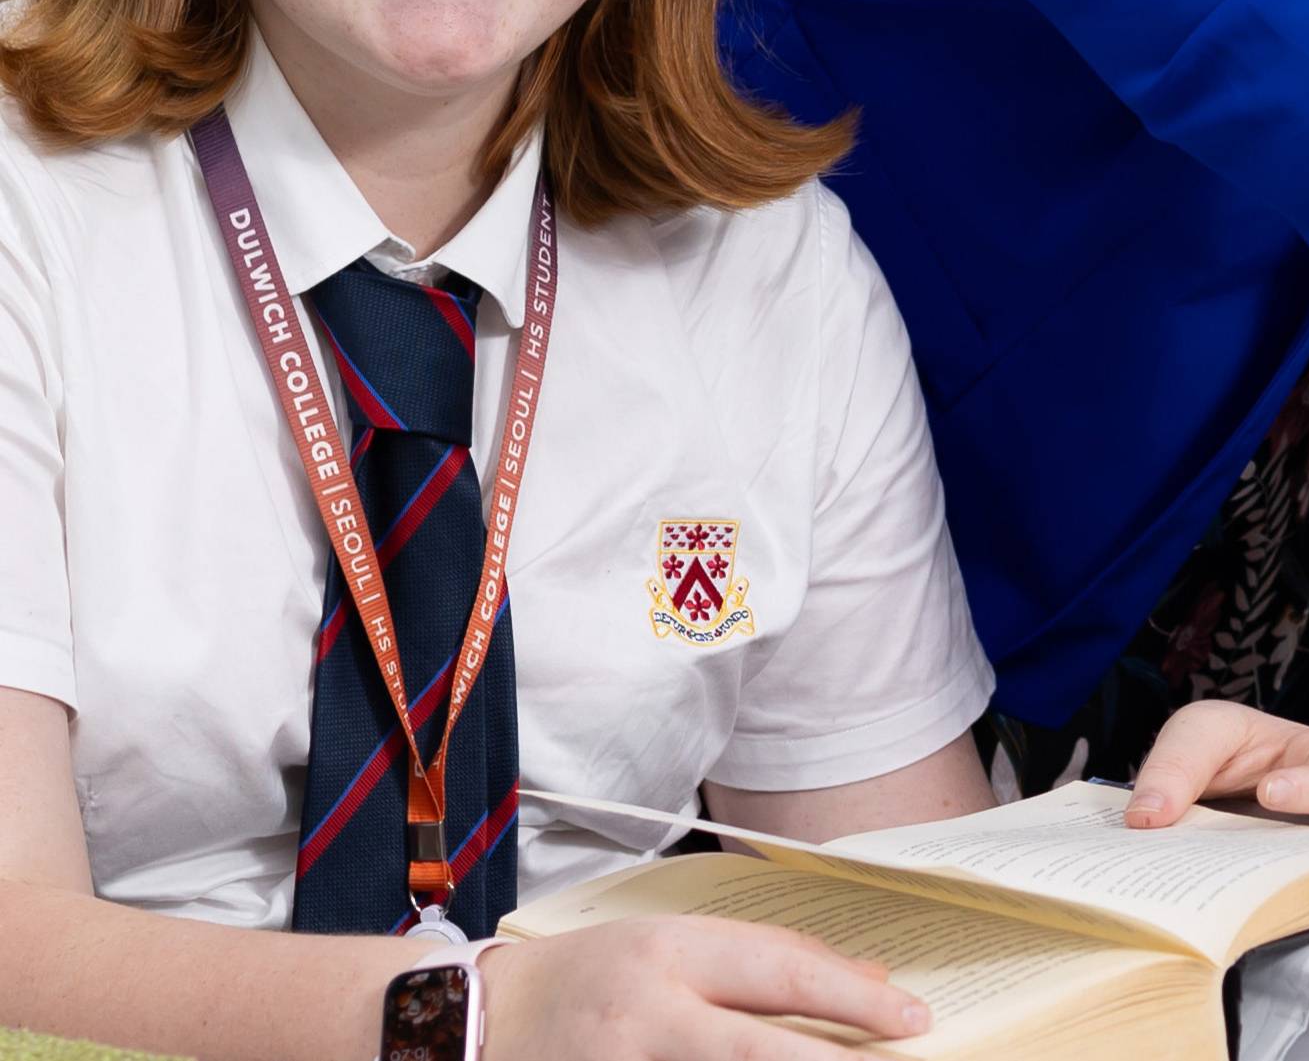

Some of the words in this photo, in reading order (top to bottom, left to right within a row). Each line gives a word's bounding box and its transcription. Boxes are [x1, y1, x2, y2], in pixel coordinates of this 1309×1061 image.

[533, 193, 552, 316] STUDENT
[527, 322, 544, 360] HS
[229, 207, 292, 344] DULWICH
[280, 351, 340, 481] COLLEGE
[330, 498, 375, 591] SEOUL
[371, 616, 392, 653] HS
[505, 385, 534, 475] SEOUL
[480, 492, 513, 622] COLLEGE
